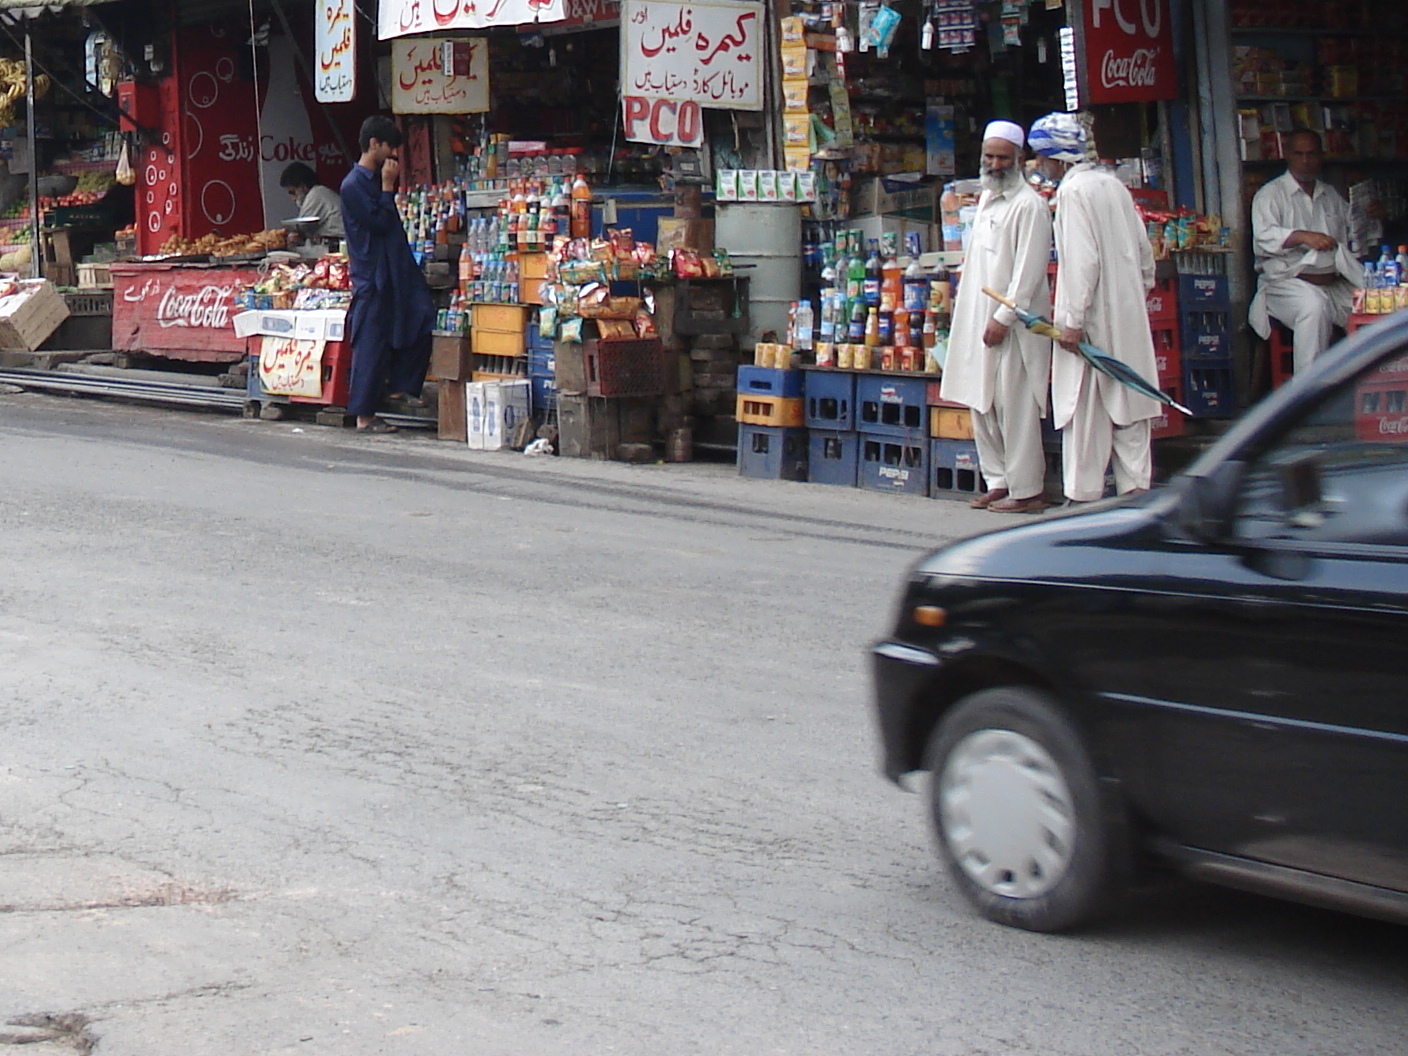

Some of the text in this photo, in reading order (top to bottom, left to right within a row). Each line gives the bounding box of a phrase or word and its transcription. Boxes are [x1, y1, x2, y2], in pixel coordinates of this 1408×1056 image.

[695, 11, 757, 66] کیمرہ
[623, 95, 701, 144] PCO
[260, 135, 315, 162] Coke
[157, 285, 230, 329] Coca-Cola
[879, 466, 909, 481] PEPSI
